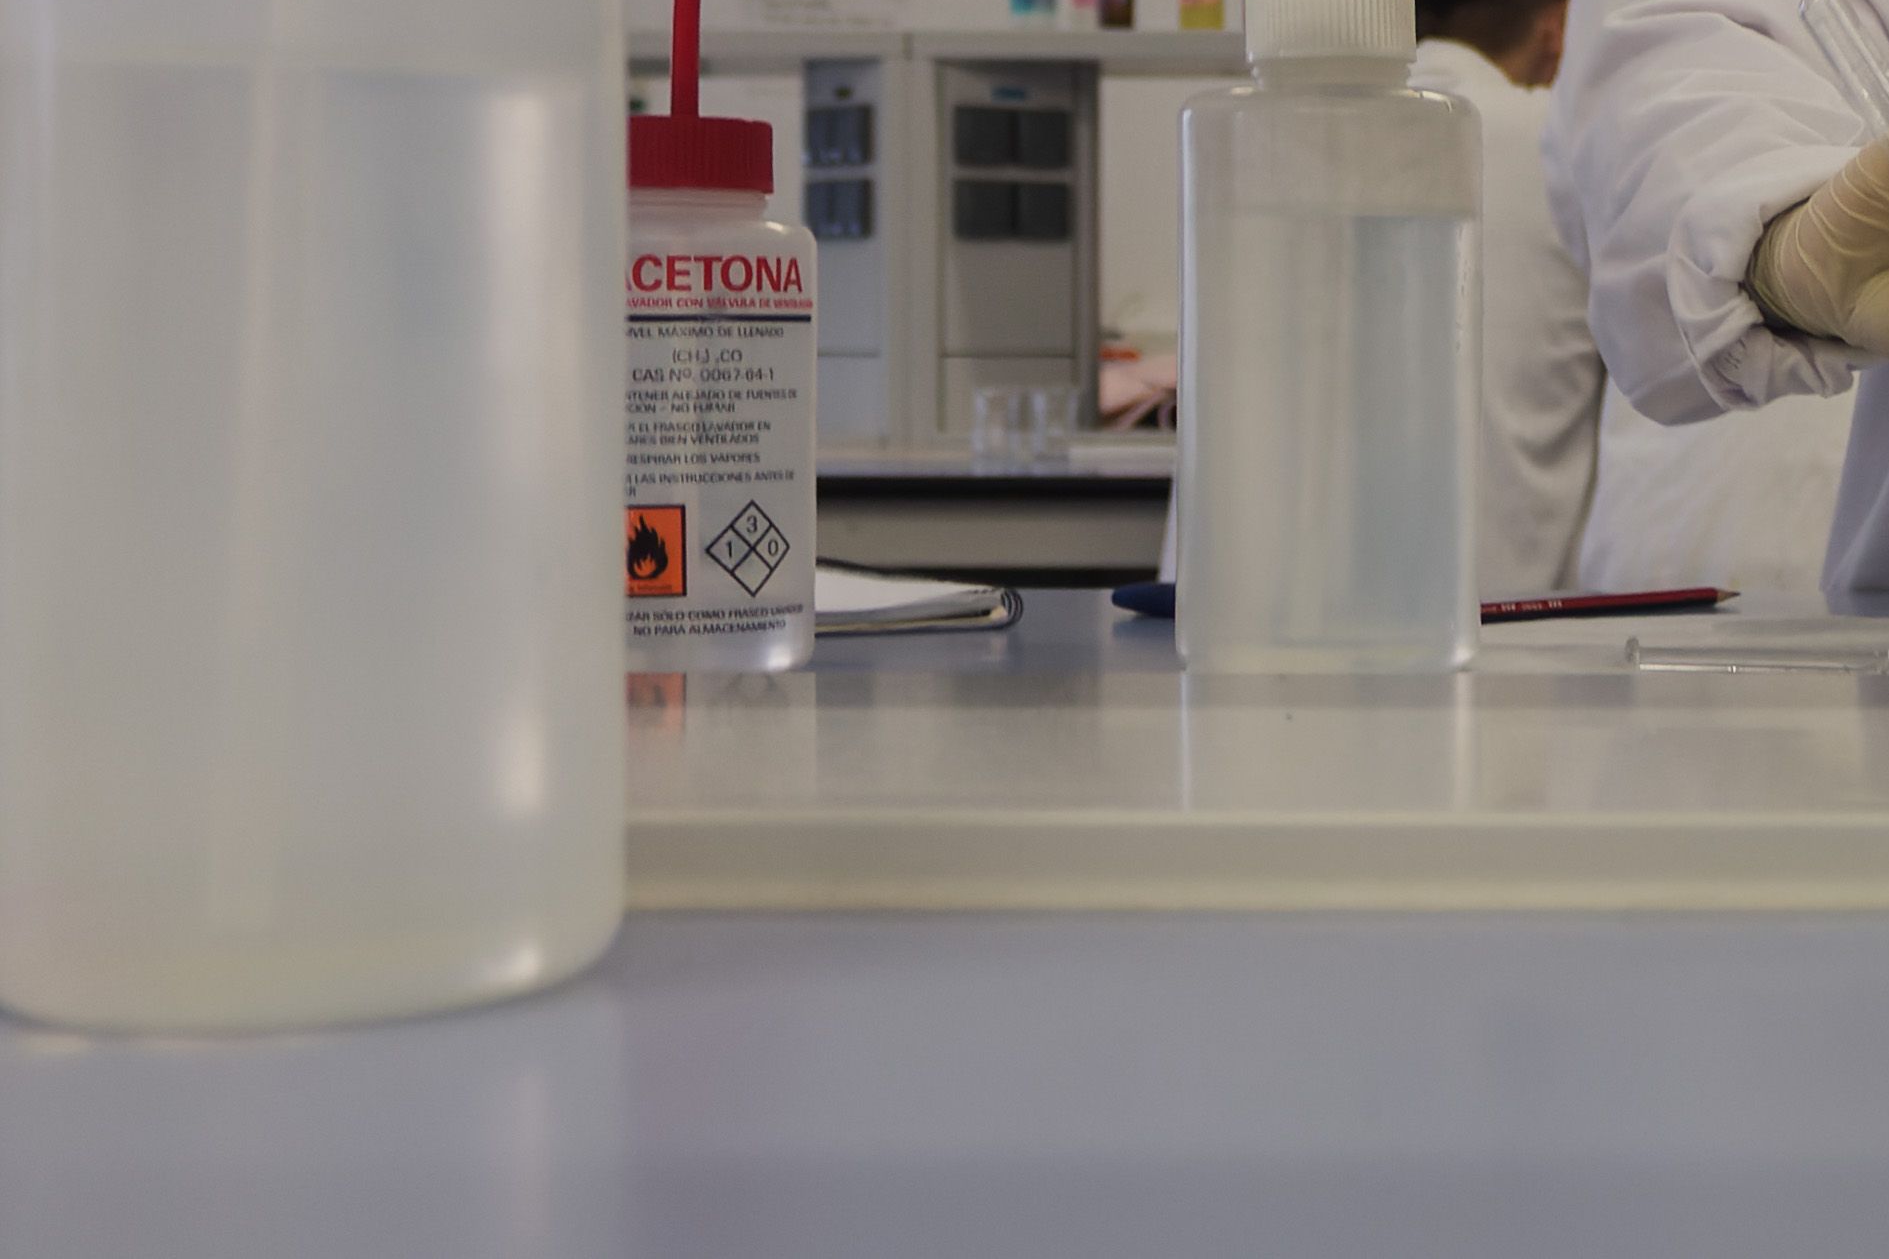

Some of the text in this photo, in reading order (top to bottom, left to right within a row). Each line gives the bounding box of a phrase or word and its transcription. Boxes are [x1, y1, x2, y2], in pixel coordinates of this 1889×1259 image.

[626, 254, 803, 293] CETONA
[718, 326, 733, 337] DE
[632, 369, 664, 382] CAS
[746, 515, 758, 534] 3
[725, 539, 779, 559] 1 0
